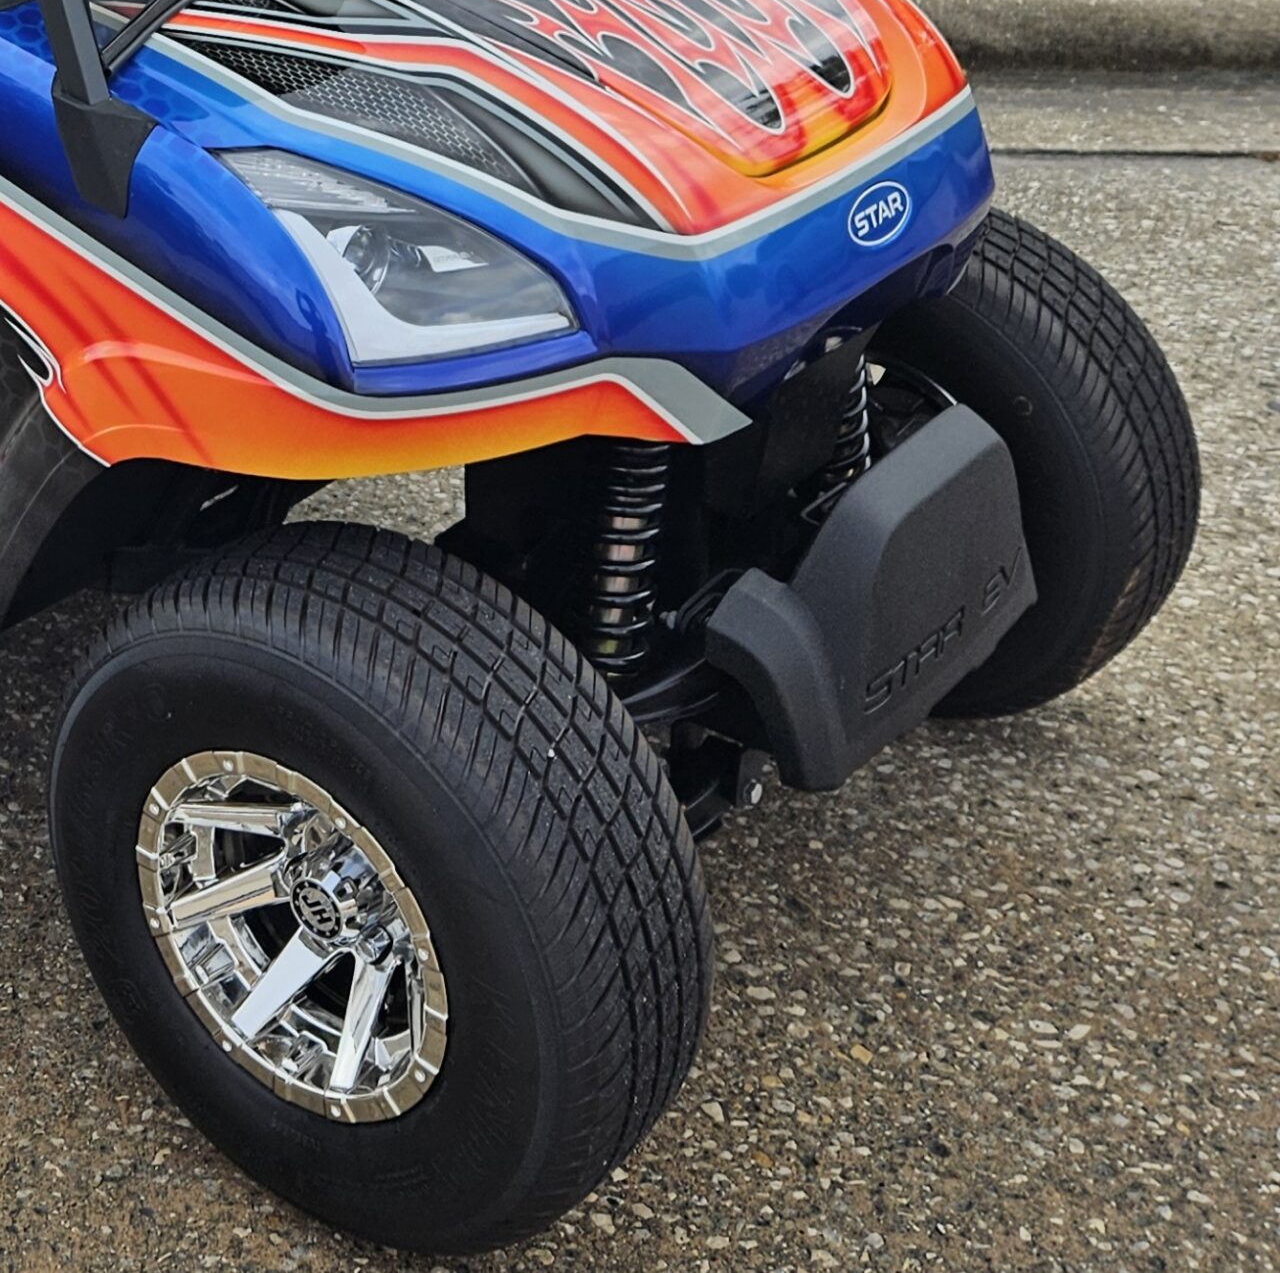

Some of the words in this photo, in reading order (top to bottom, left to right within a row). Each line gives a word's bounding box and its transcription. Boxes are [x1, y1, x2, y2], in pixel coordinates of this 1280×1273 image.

[854, 191, 904, 237] STAR
[864, 605, 966, 715] STAR
[980, 546, 1022, 615] EV
[301, 889, 334, 927] JH
